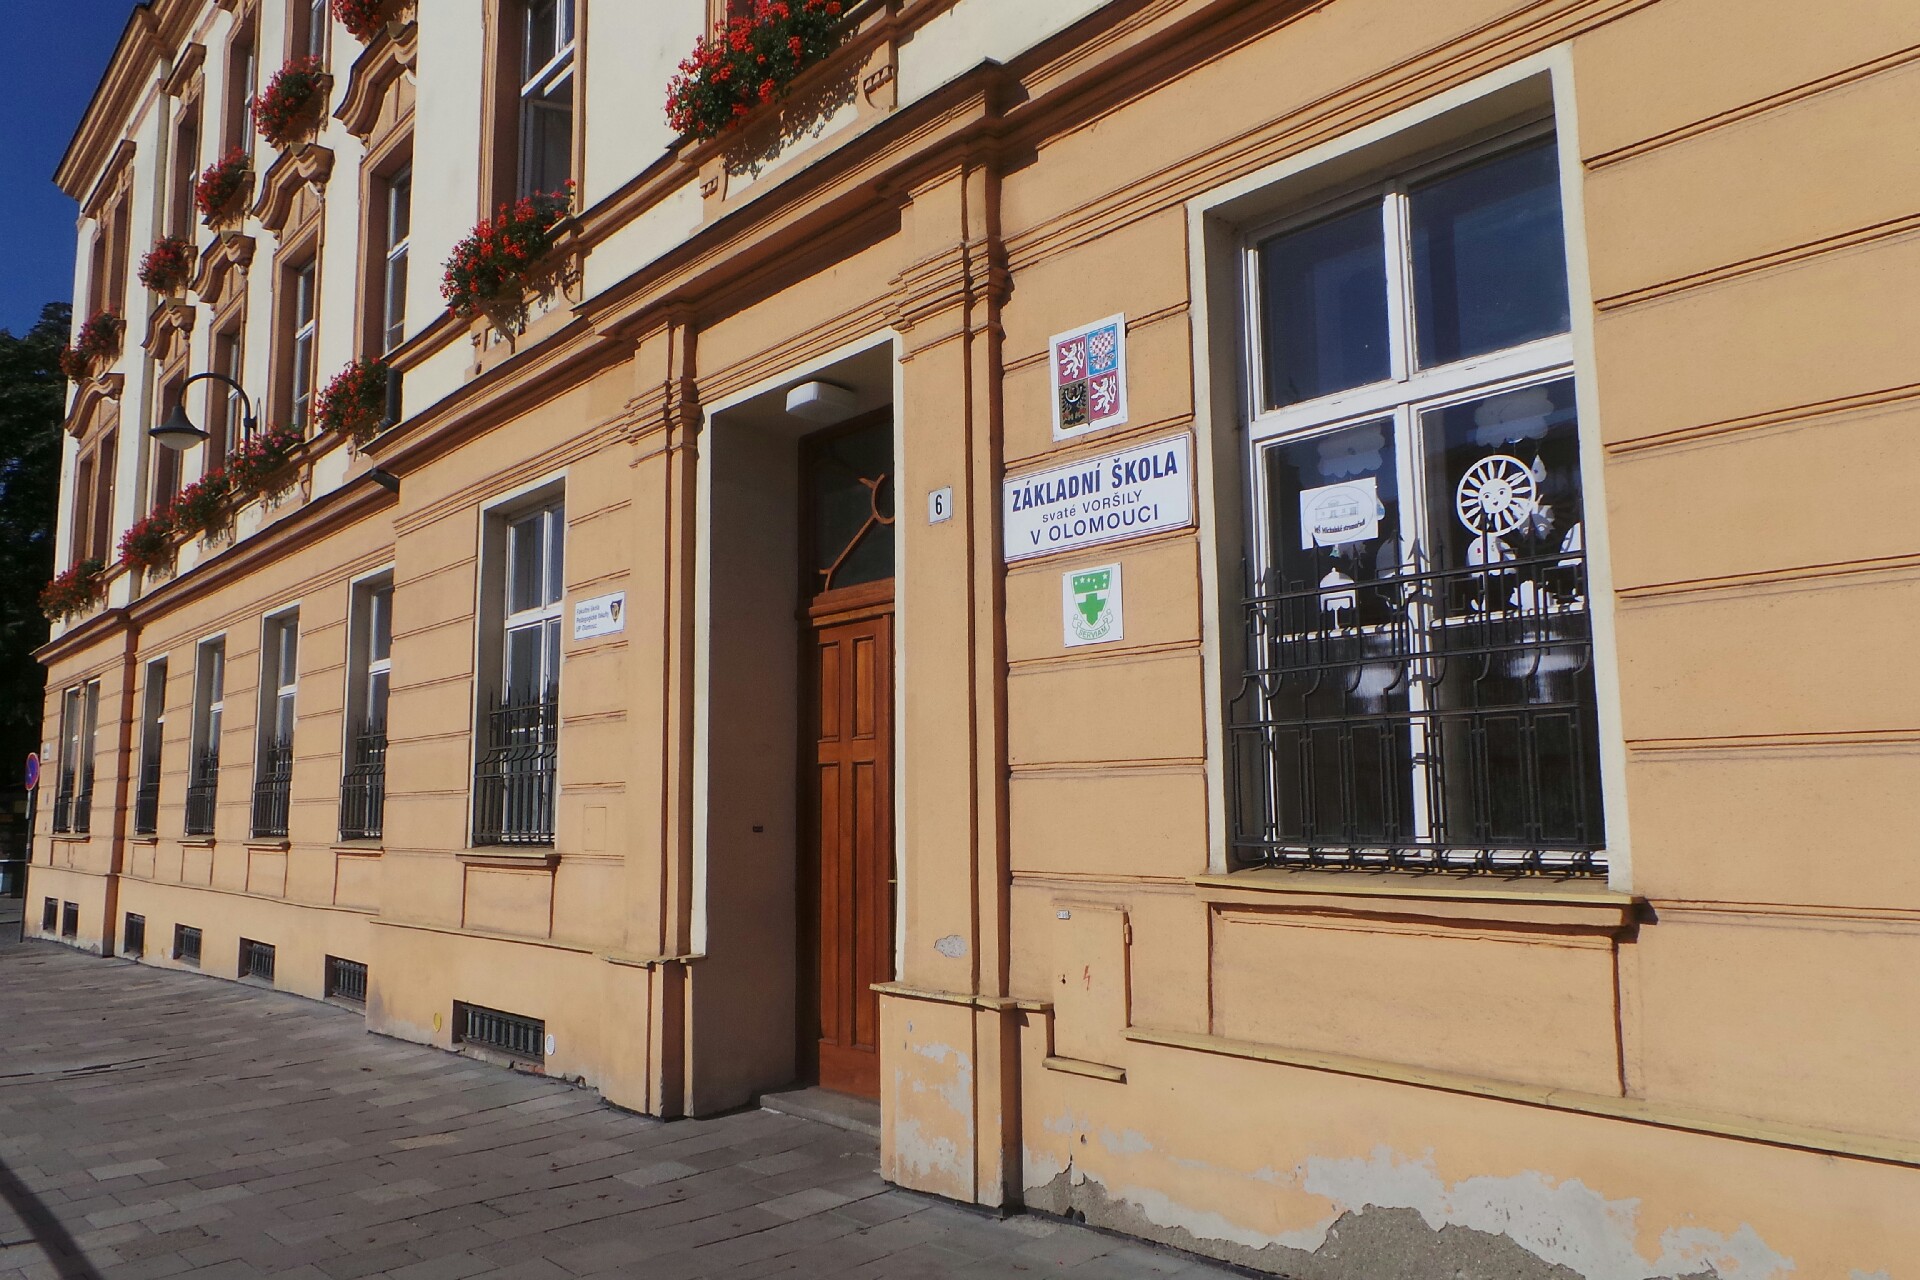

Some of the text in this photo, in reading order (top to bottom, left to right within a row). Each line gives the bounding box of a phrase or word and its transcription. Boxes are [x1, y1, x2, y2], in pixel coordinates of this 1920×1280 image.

[1012, 450, 1178, 512] ZÁKLADNÍ ŠKOLA
[935, 494, 943, 515] 6
[1042, 489, 1142, 523] svaté VORŠILY
[1030, 503, 1158, 545] V OLOMOUCI
[1078, 625, 1109, 639] SERVIAM
